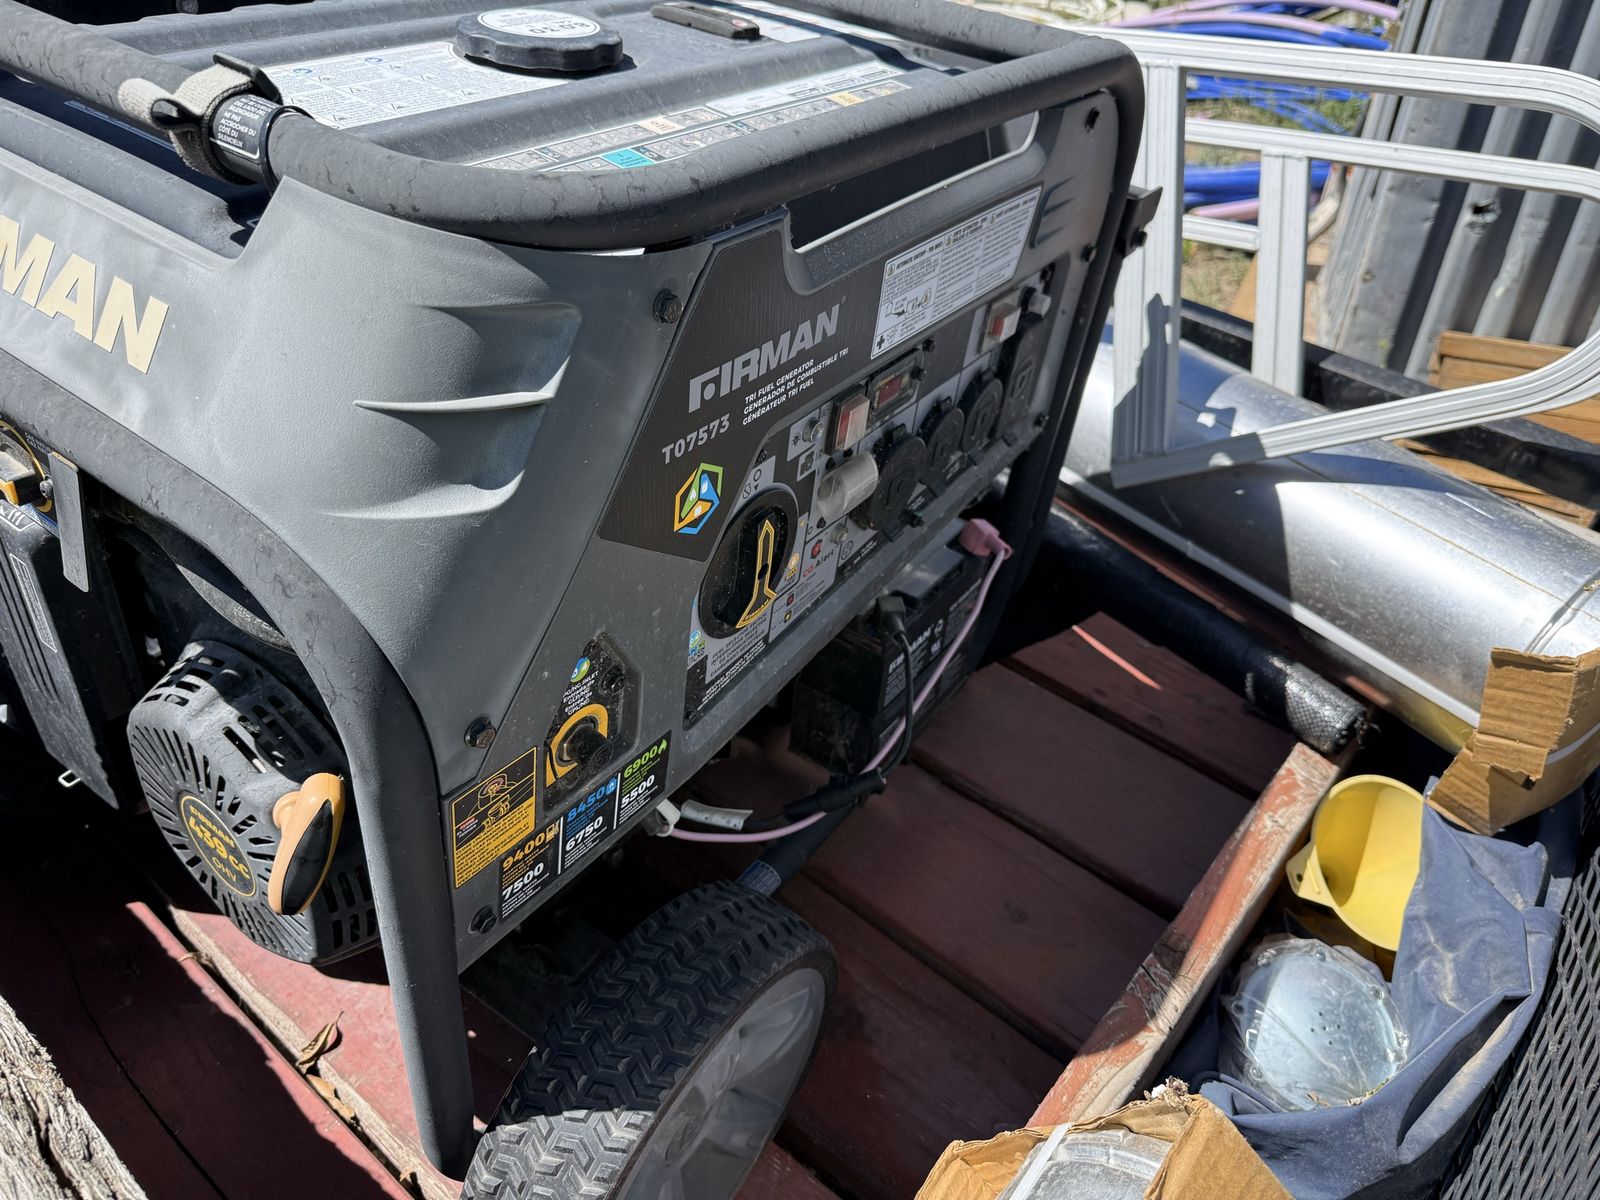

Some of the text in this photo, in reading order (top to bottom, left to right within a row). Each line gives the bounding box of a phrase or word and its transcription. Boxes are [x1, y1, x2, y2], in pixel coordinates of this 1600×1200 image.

[688, 303, 840, 413] FIRMAN
[743, 347, 849, 415] GENERADOR DE COMBUSTIBLE TRI
[744, 359, 814, 405] TRI FUEL GENERATOR
[742, 378, 814, 426] GÉNÉRATEUR TRI FUEL
[661, 413, 730, 464] T07573
[624, 745, 658, 778] 6900
[567, 786, 605, 822] 8450
[621, 774, 655, 808] 5500
[502, 833, 545, 872] 9400
[565, 816, 603, 851] 6750
[502, 862, 544, 901] 7500
